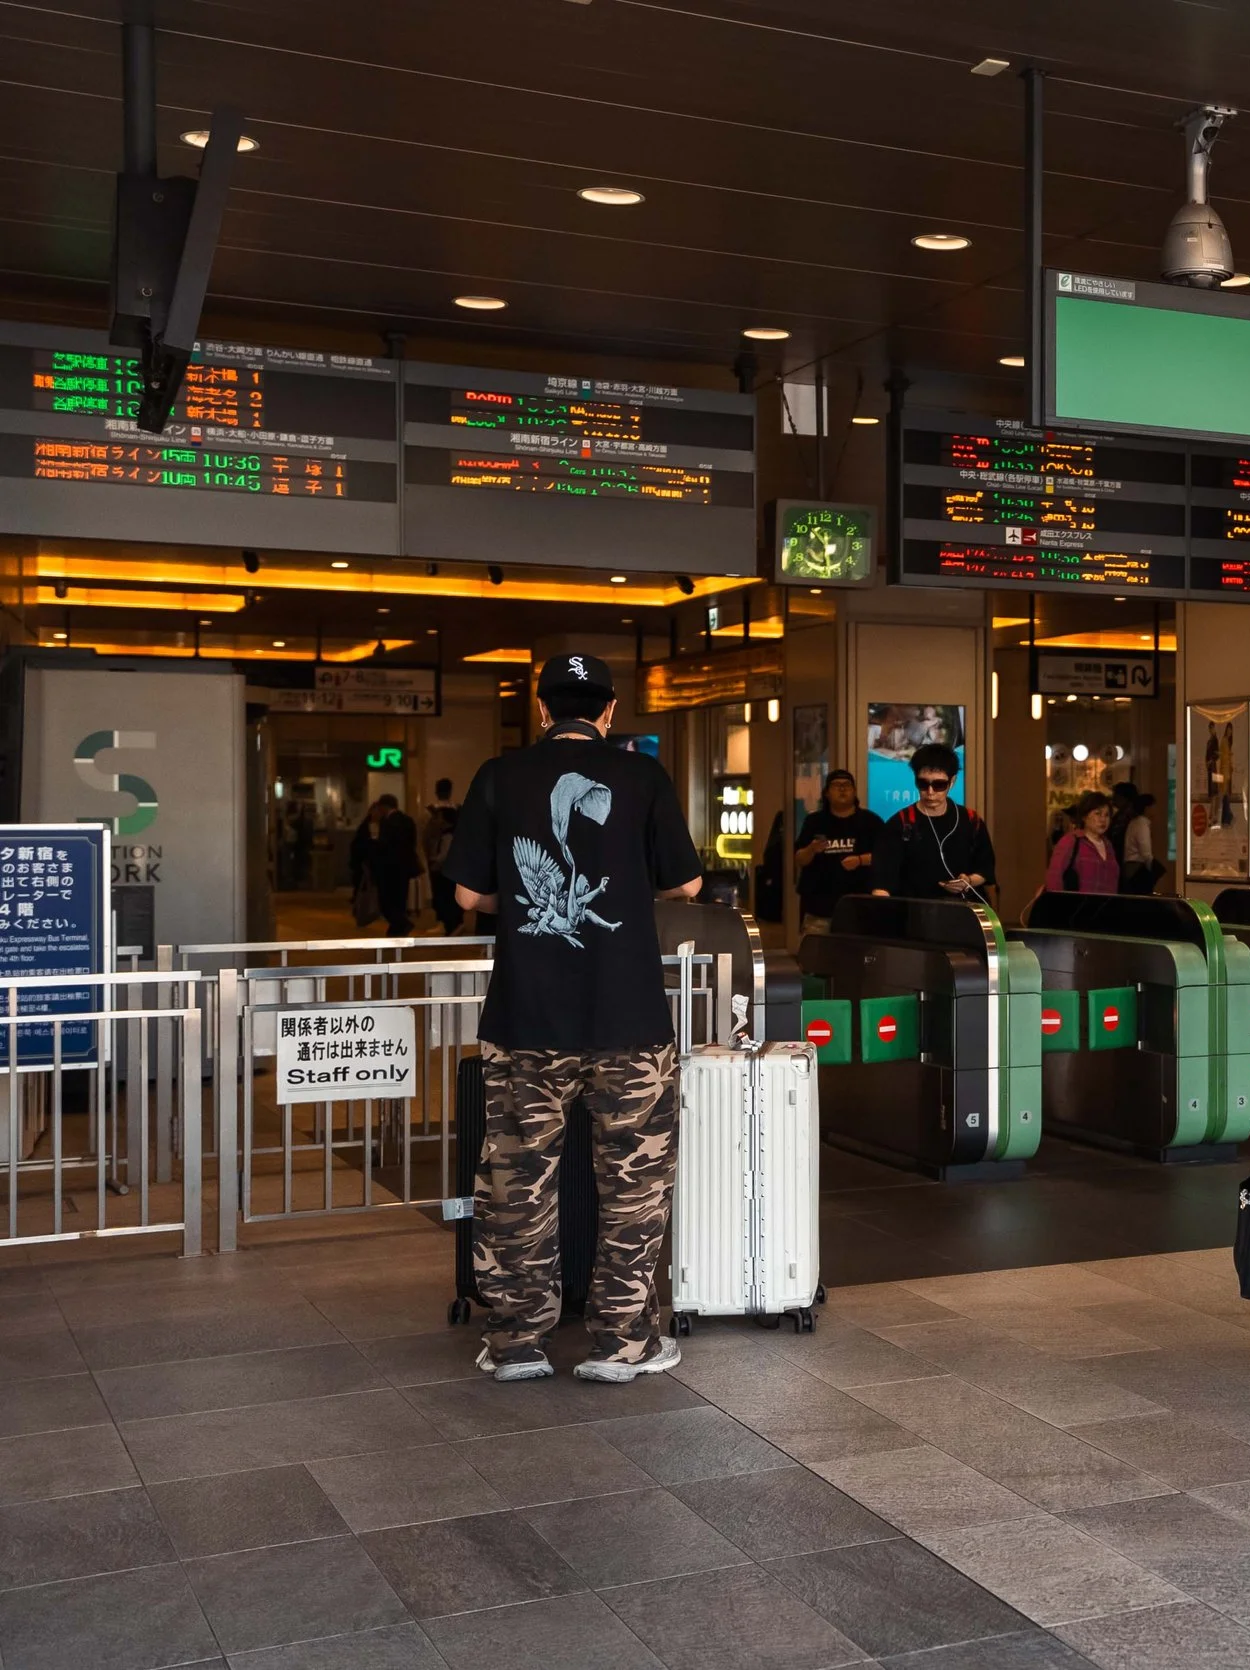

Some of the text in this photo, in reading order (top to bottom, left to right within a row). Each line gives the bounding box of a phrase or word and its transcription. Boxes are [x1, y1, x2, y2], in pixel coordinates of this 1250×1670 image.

[510, 432, 579, 448] 湘南新宿ライン
[796, 525, 808, 533] 10
[1040, 529, 1093, 540] 成田エクスプレス
[367, 748, 402, 768] JR
[281, 1015, 375, 1038] 関係者以外の
[297, 1038, 408, 1061] 通行は出来ません
[287, 1064, 409, 1085] Staff only
[1191, 1101, 1198, 1109] 4
[1238, 1097, 1245, 1106] 3
[970, 1115, 977, 1125] 5
[1022, 1112, 1029, 1121] 4
